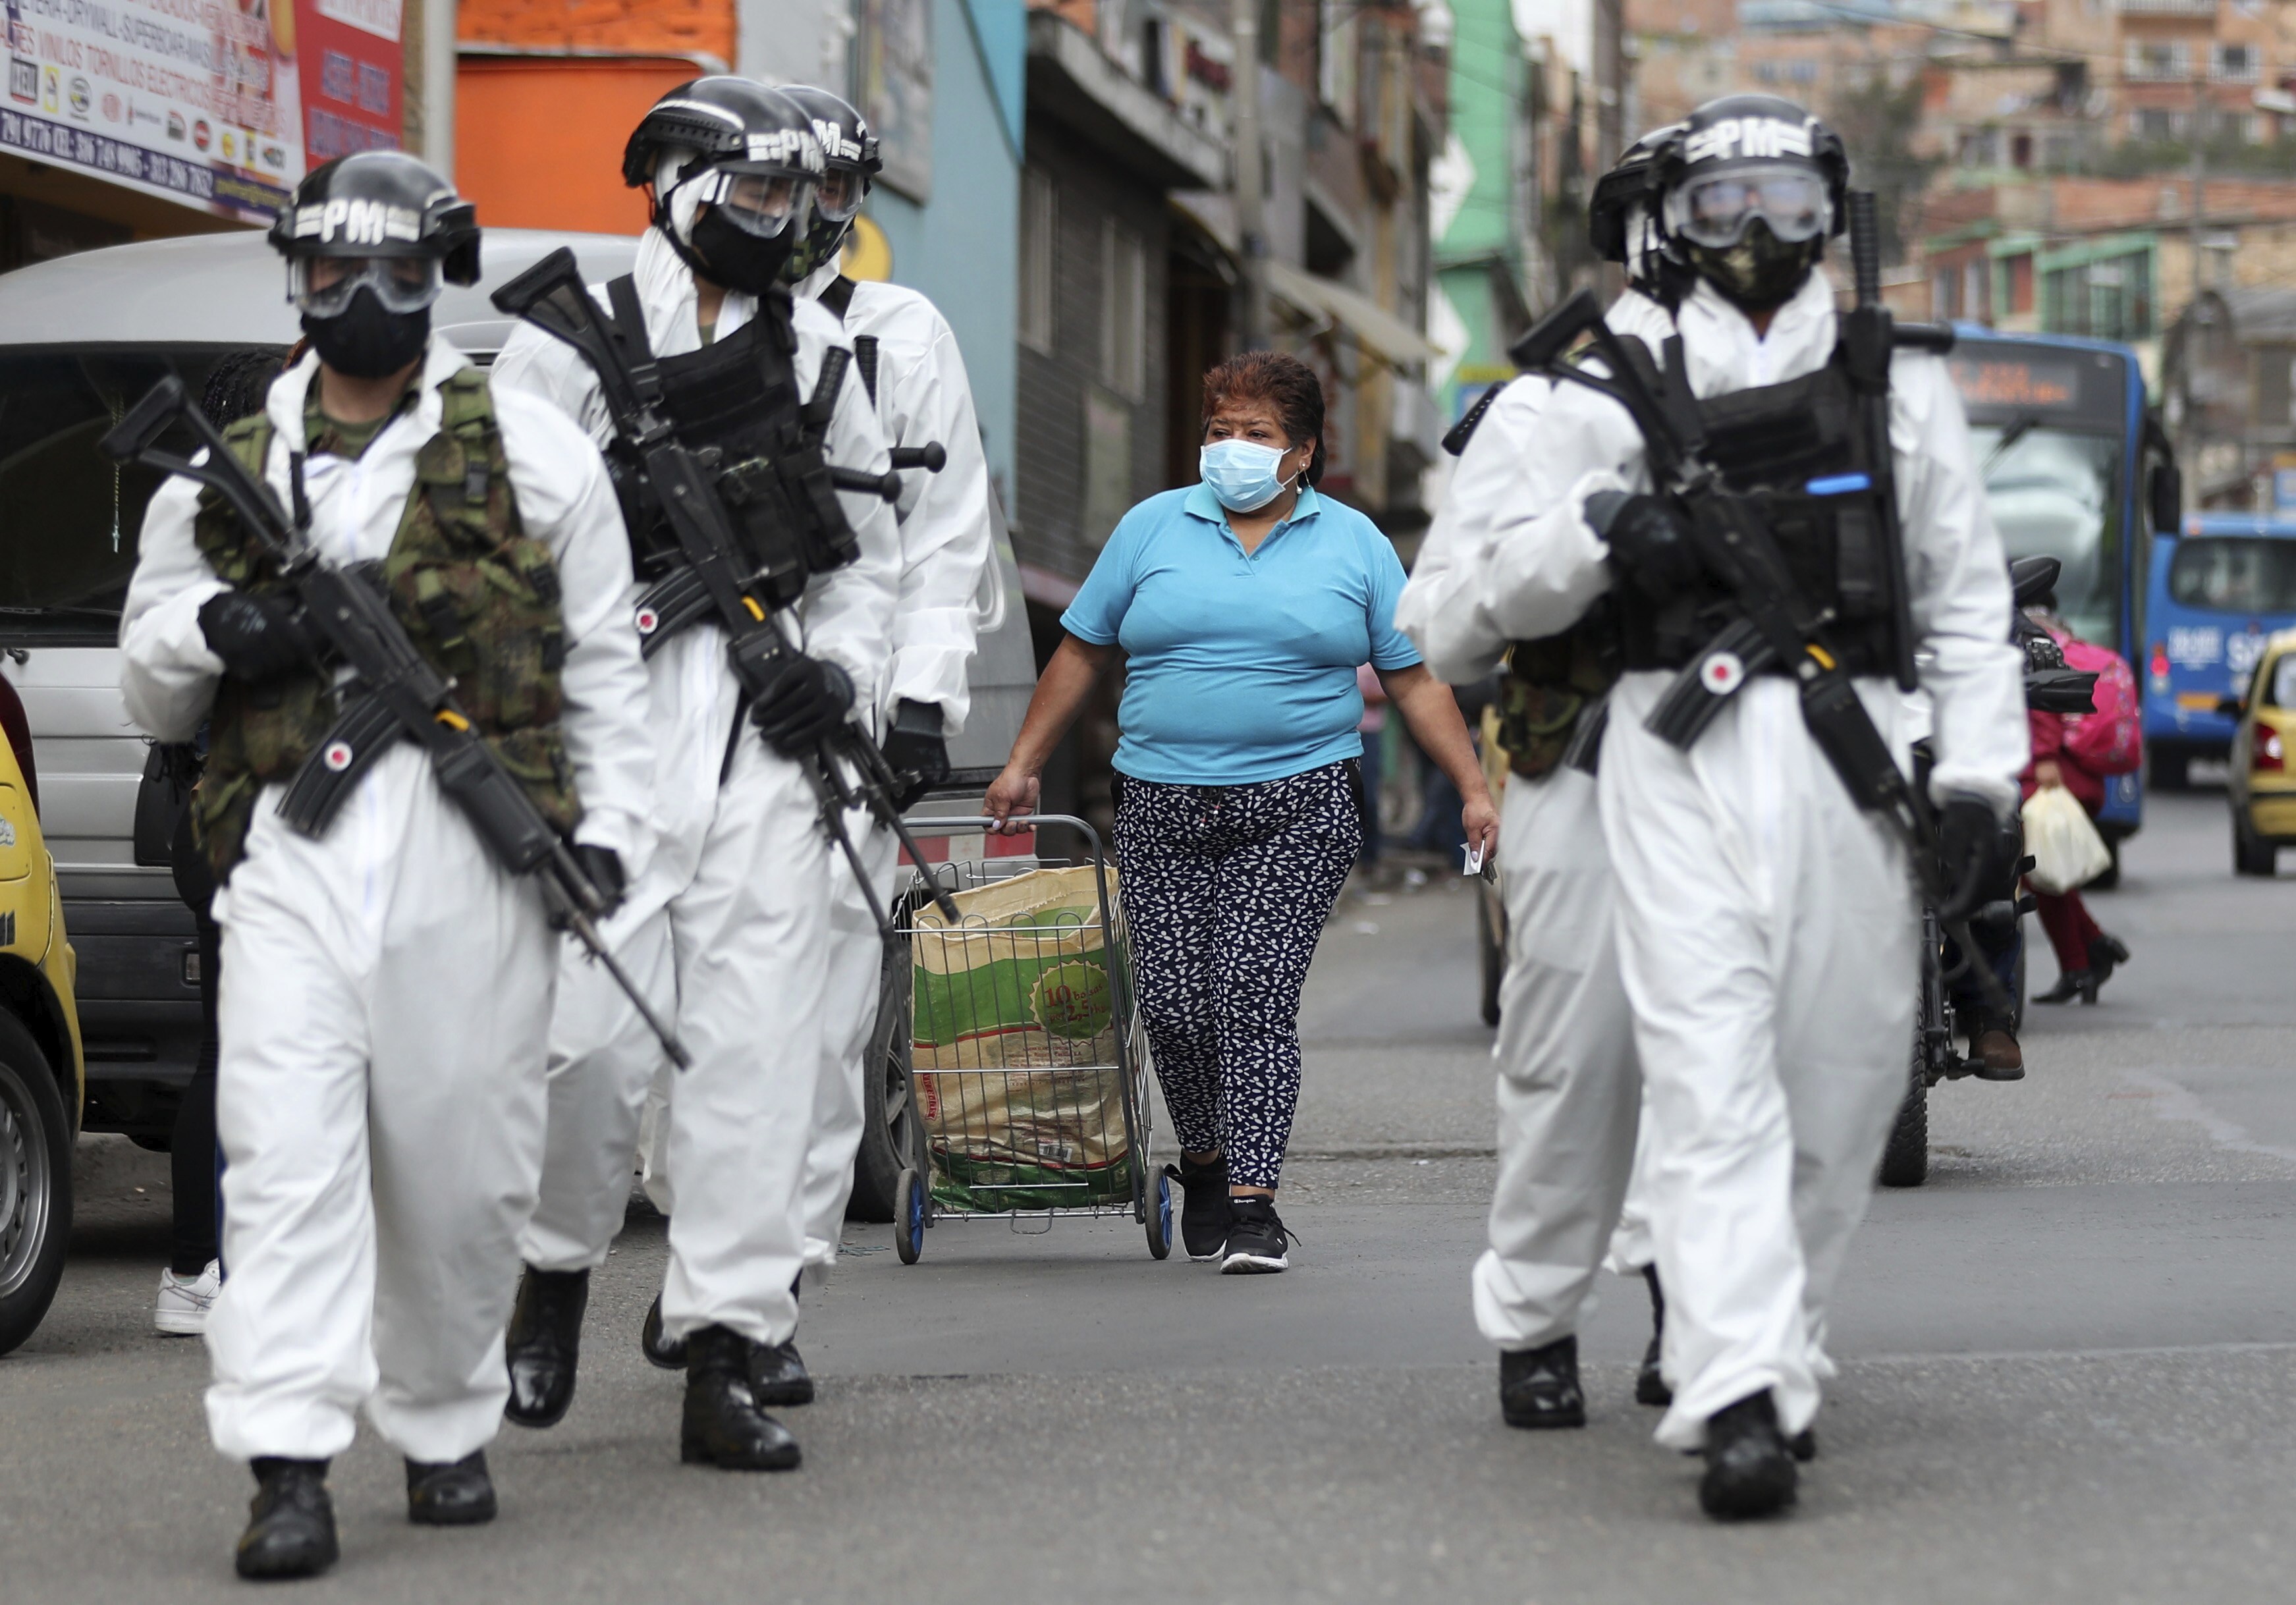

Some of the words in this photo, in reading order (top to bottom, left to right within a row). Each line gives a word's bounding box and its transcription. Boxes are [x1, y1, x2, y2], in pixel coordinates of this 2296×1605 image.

[1713, 116, 1782, 160] PM
[321, 198, 387, 246] PM
[1044, 985, 1072, 1008] 10
[1072, 983, 1103, 1001] bosas
